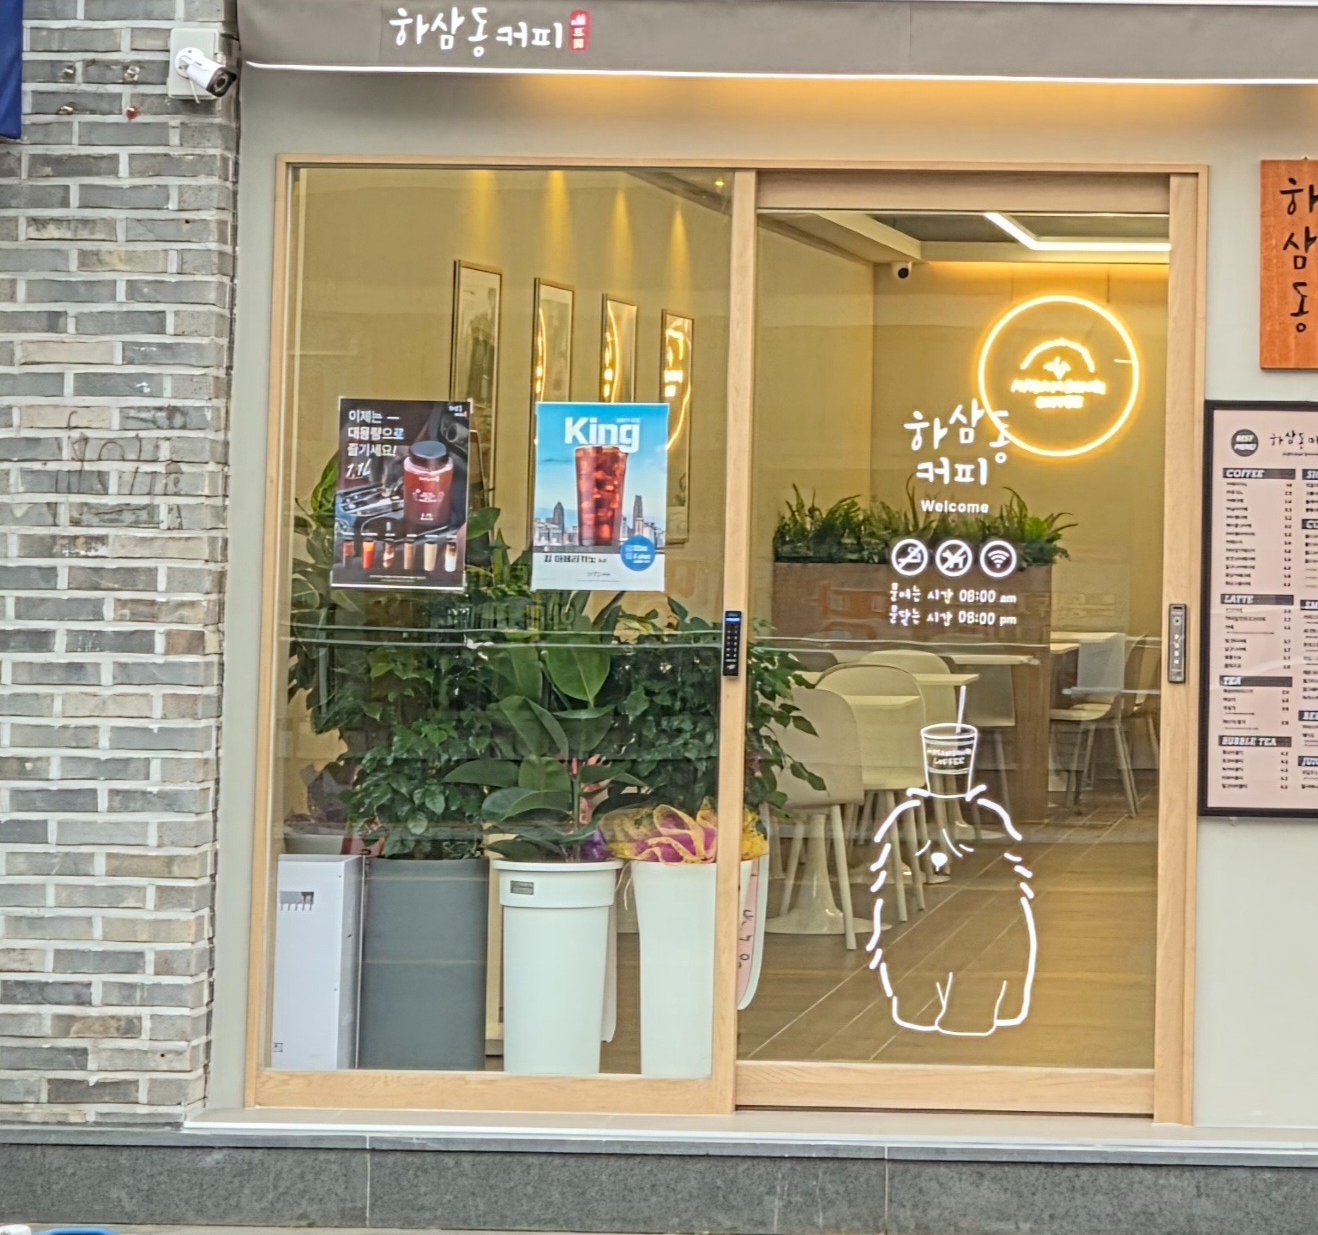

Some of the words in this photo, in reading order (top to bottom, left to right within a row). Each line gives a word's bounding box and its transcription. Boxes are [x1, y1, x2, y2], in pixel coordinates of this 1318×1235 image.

[348, 409, 383, 424] 이제는
[347, 426, 405, 441] 대용량으로
[564, 416, 640, 453] King
[904, 398, 1010, 464] 하삼동
[347, 443, 398, 457] 즐기세요!
[916, 457, 989, 485] 커피
[1226, 469, 1265, 478] COFFEE
[921, 500, 989, 513] Welcome
[927, 589, 954, 604] 시간
[959, 589, 996, 603] 08:00
[1000, 595, 1017, 603] am
[1224, 595, 1255, 604] LATTE
[926, 611, 953, 626] 시간
[958, 611, 996, 625] 08:00
[1000, 616, 1017, 626] pm
